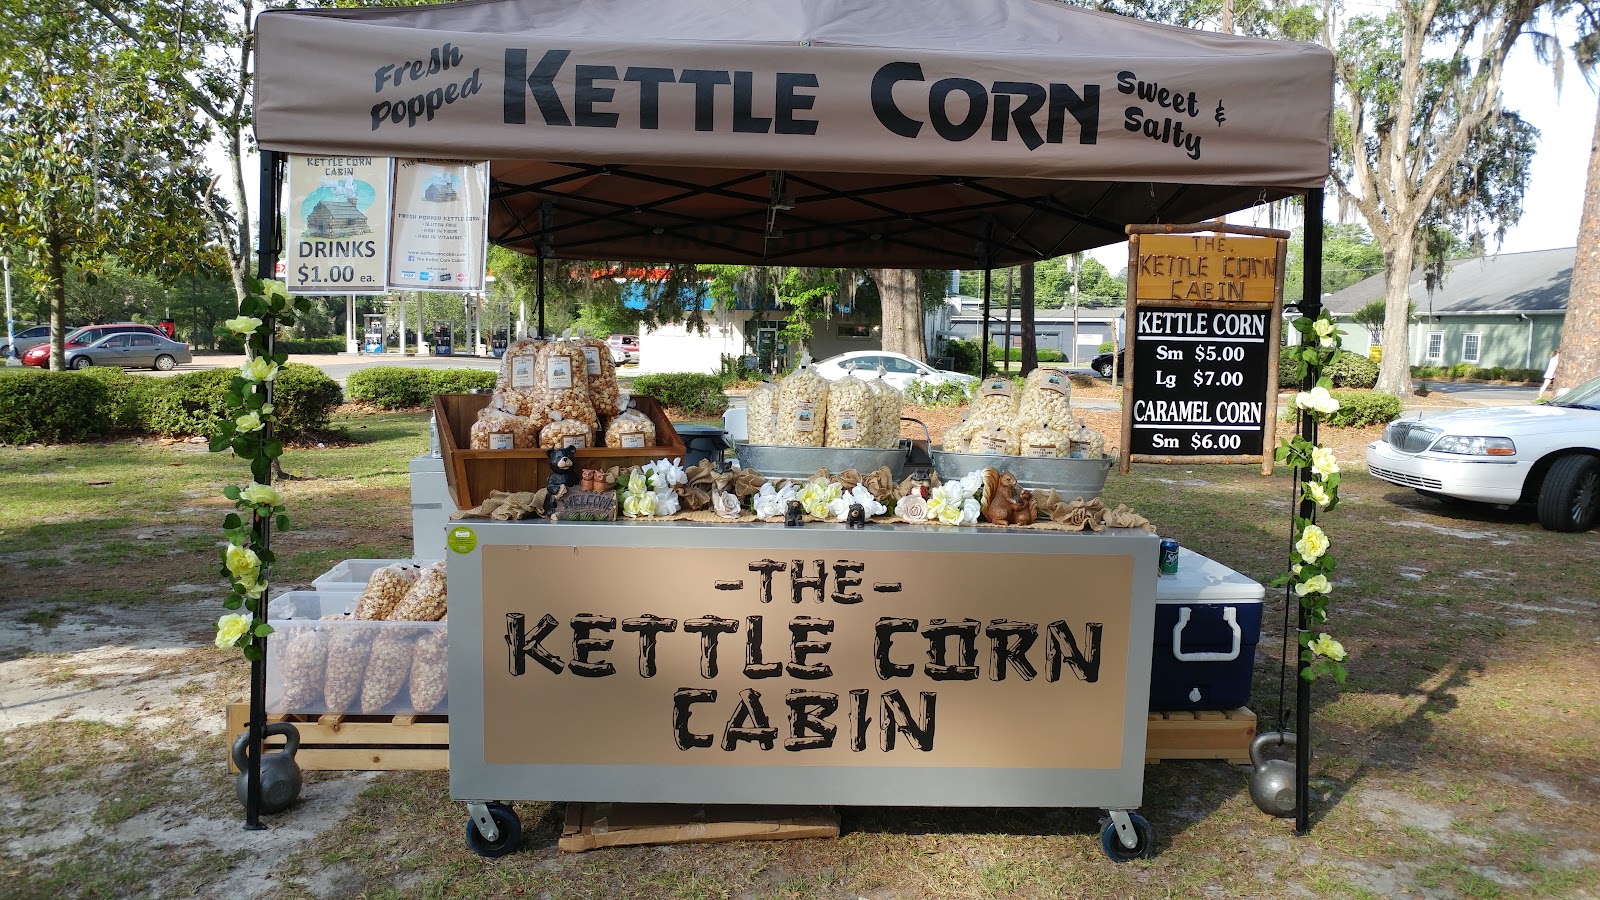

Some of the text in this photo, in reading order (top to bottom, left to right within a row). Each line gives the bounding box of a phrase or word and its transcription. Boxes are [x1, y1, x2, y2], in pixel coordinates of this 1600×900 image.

[375, 42, 464, 94] Fresh
[503, 47, 1101, 152] KETTLE CORN
[1116, 69, 1227, 128] Sweet &
[1123, 106, 1201, 161] Salty
[306, 157, 372, 167] KETTLE CORN
[325, 167, 354, 176] CABIN
[401, 160, 416, 169] THE
[298, 240, 376, 258] DRINKS
[297, 263, 376, 285] $1.00 ea.
[1139, 253, 1209, 278] KETTLE
[1170, 278, 1245, 301] CABIN
[1138, 311, 1266, 337] KETTLE CORN
[1155, 344, 1246, 363] Sm $5.00
[1155, 369, 1244, 388] Lg $7.00
[1133, 399, 1263, 424] CARAMEL CORN
[1152, 431, 1242, 450] Sm $6.00
[503, 612, 1104, 684] KETTLE CORN
[672, 686, 938, 753] CABIN
